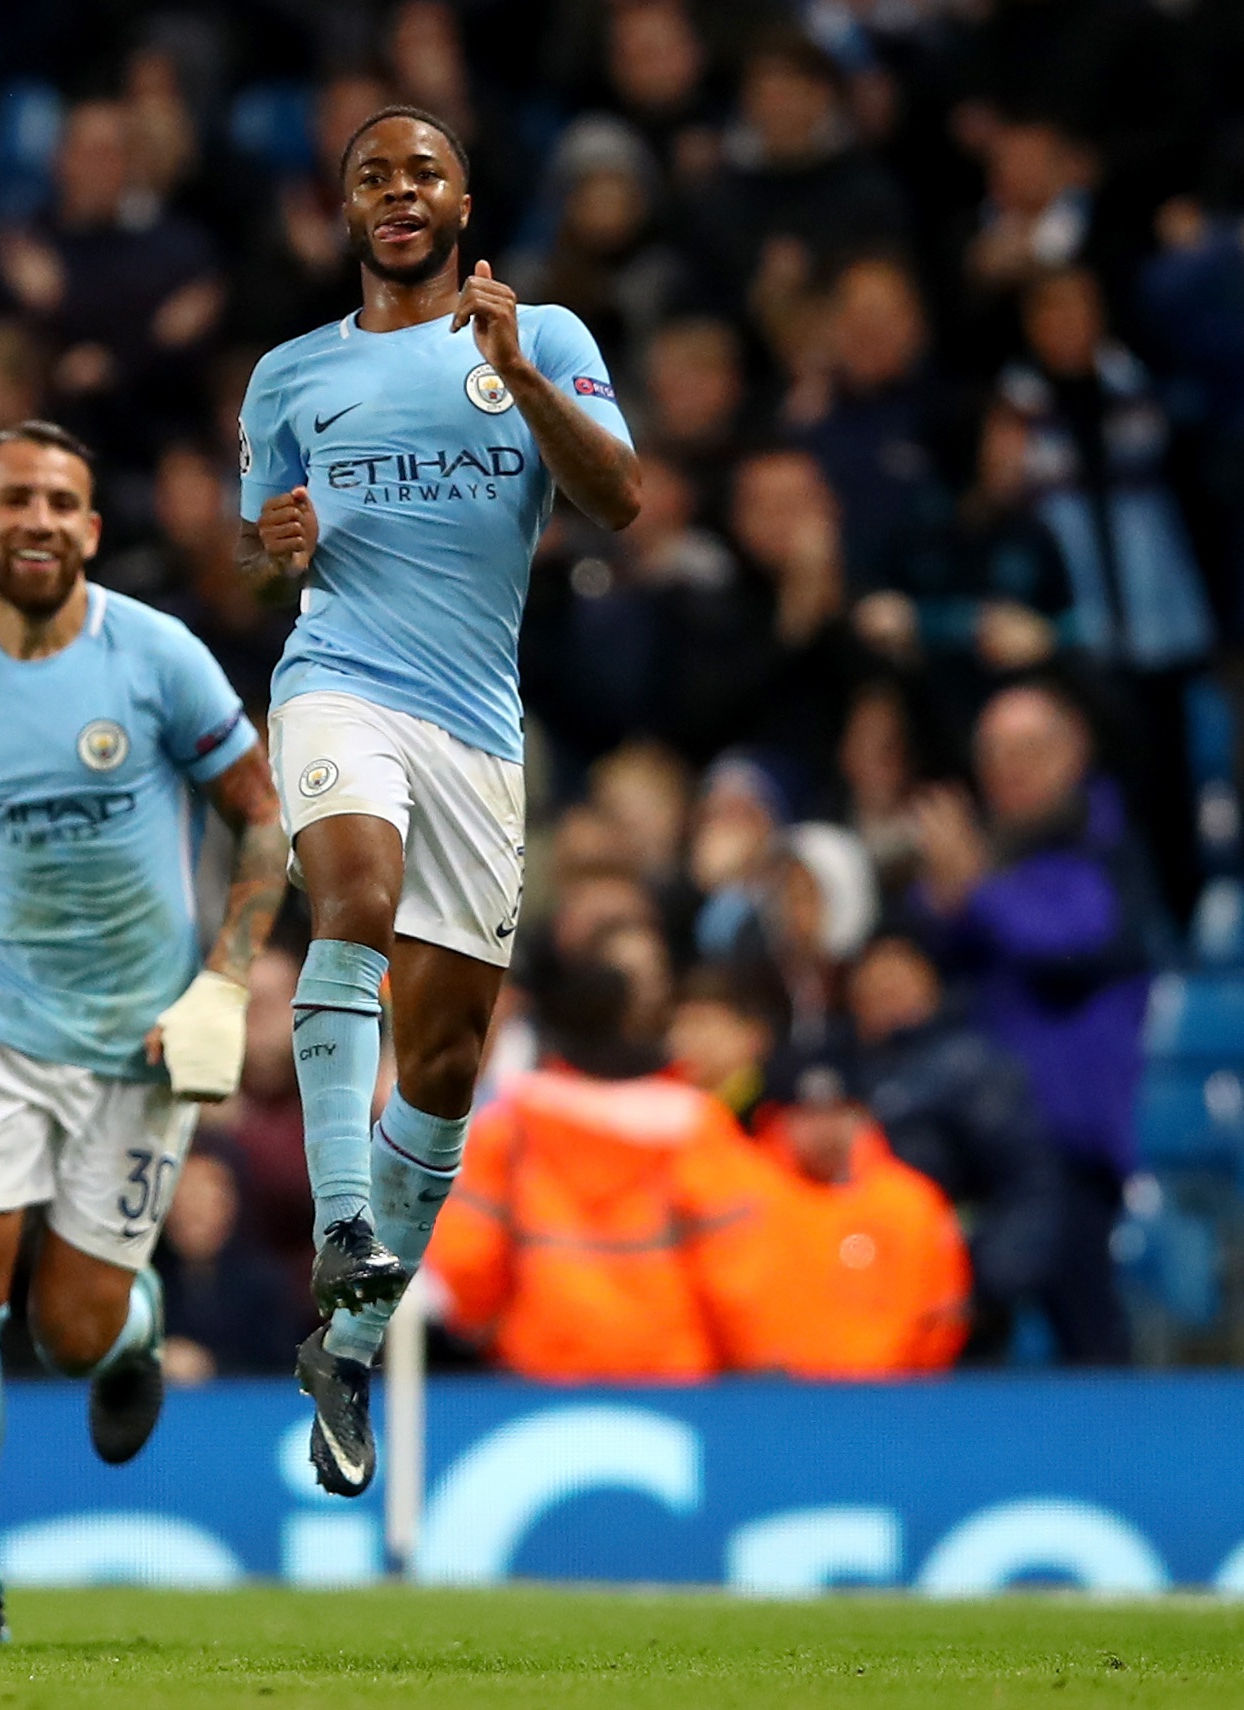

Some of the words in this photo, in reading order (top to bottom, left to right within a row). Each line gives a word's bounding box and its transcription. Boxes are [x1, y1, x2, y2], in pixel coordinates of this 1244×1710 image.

[329, 447, 525, 489] ETIHAD
[364, 483, 497, 504] AIRWAYS
[299, 1043, 336, 1061] CITY
